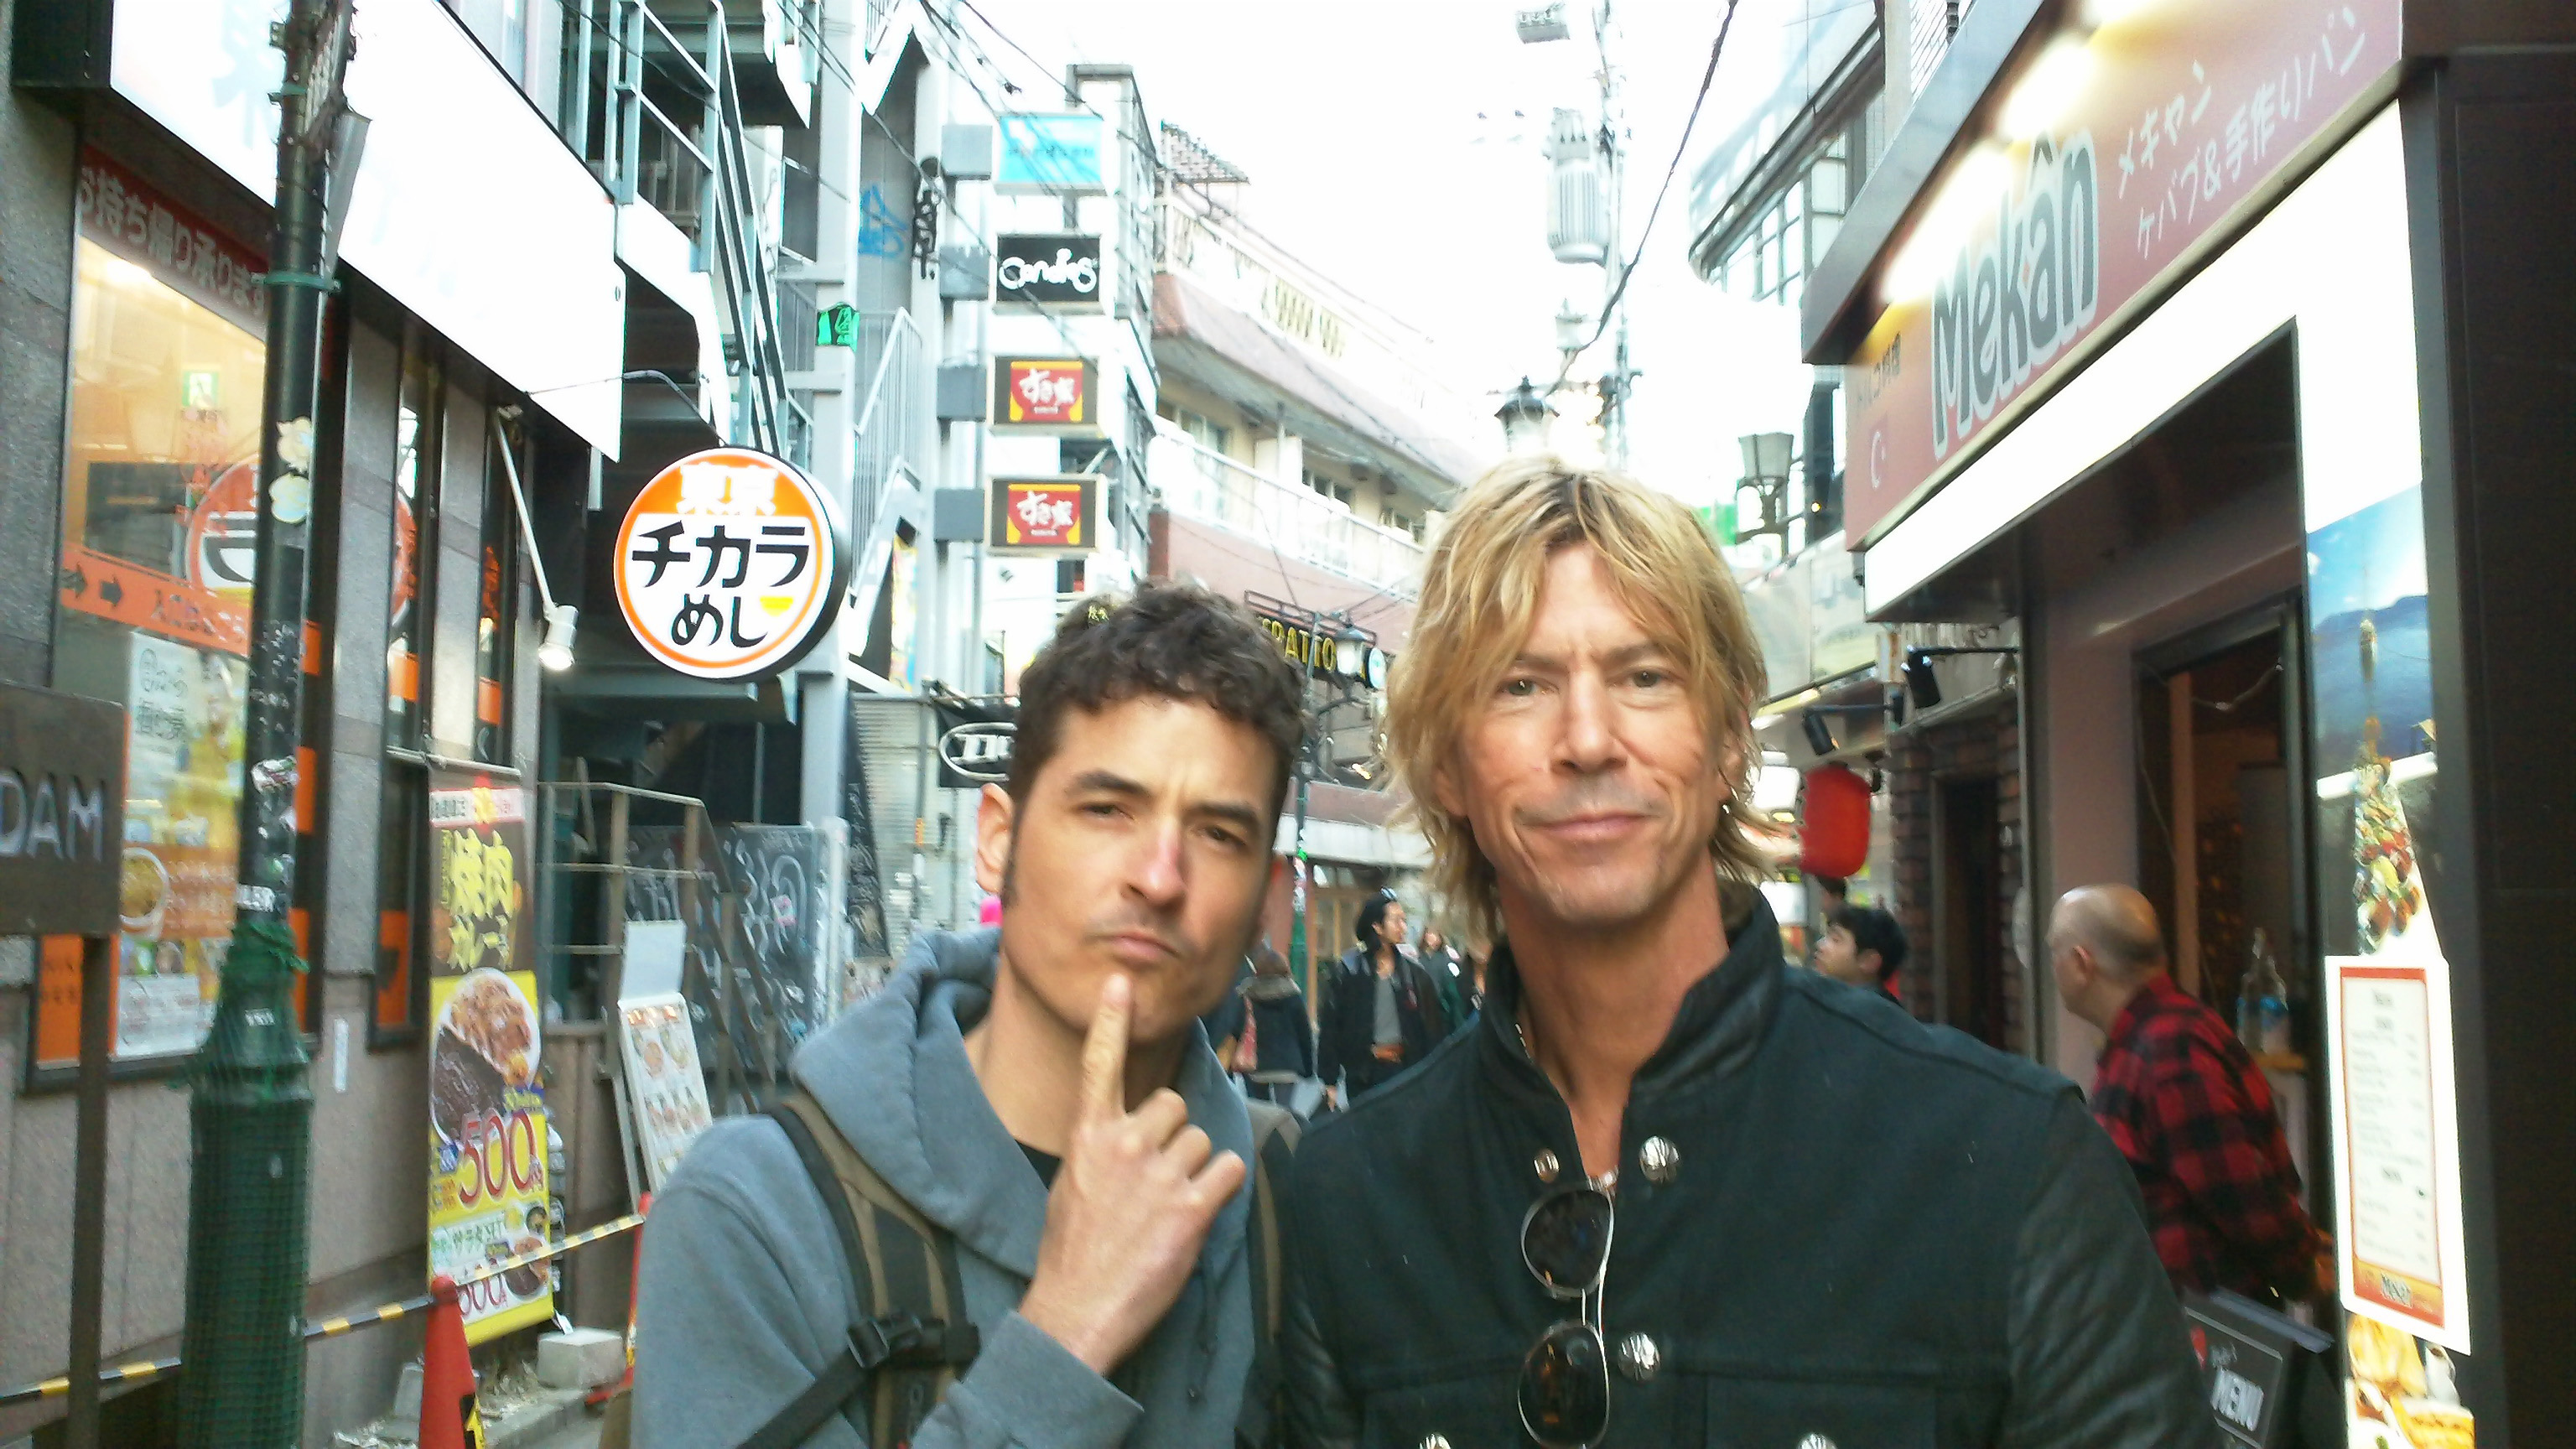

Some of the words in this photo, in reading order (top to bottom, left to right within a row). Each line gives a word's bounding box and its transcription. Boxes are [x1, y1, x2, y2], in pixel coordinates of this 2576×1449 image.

[2118, 60, 2211, 200] メキャン
[676, 461, 779, 515] 東京
[632, 520, 809, 588] チカラ
[671, 593, 768, 648] めし
